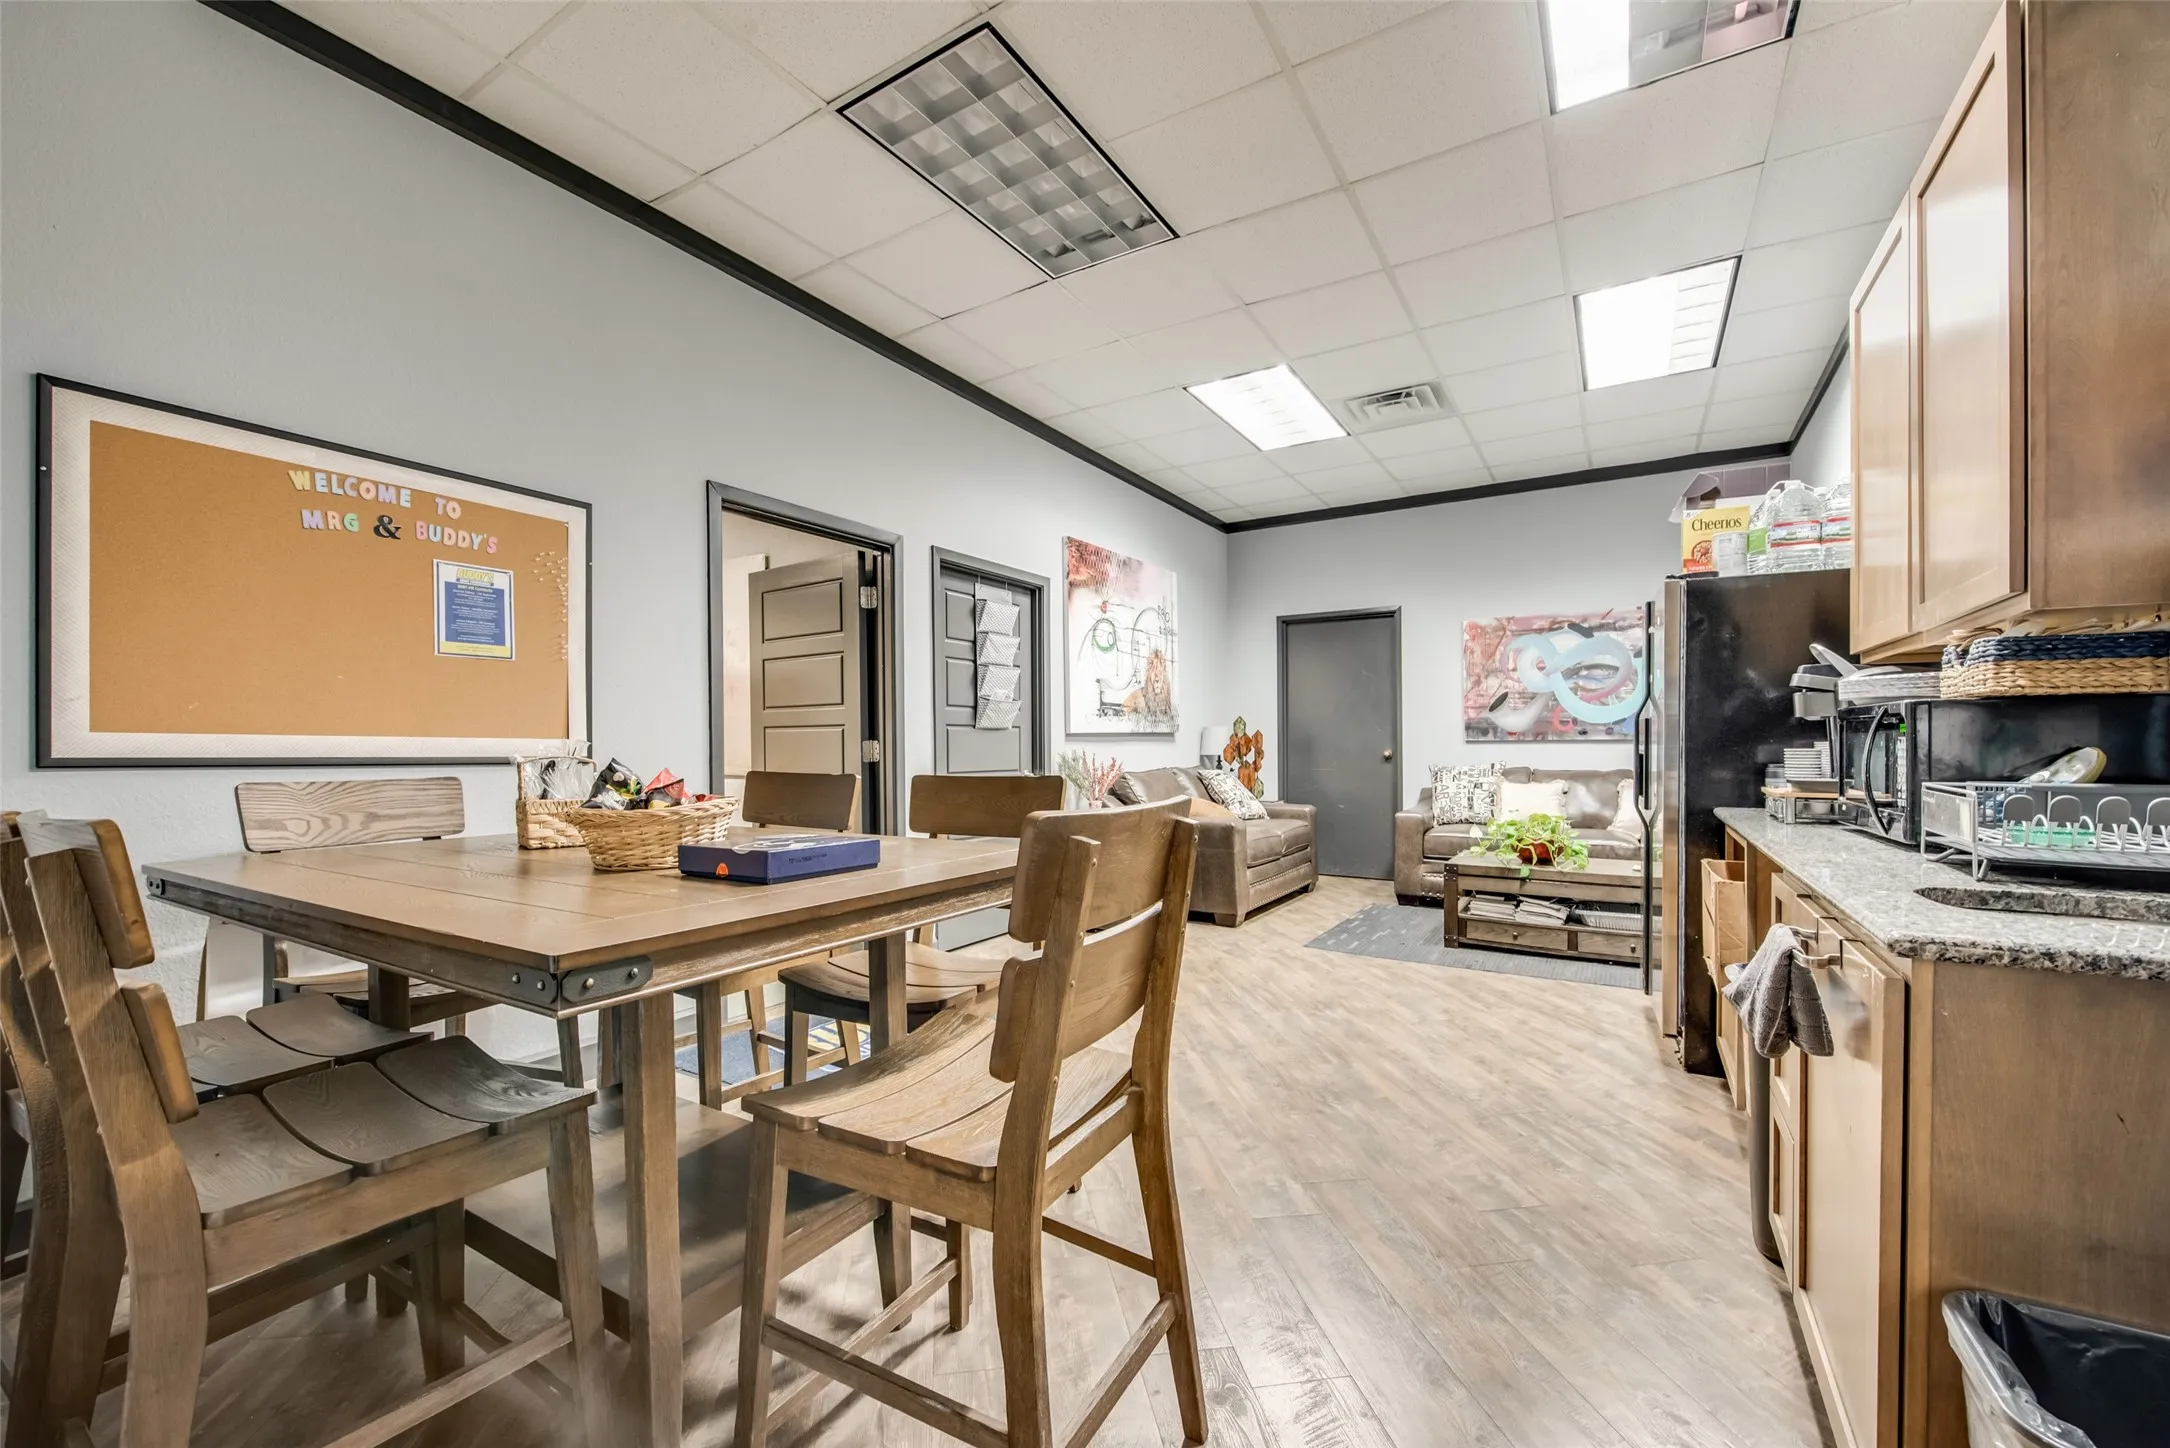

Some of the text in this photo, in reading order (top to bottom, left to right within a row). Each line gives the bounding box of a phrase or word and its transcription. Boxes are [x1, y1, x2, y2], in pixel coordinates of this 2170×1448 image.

[288, 470, 462, 520] WELCOME TO
[301, 509, 498, 554] MRG & BUDDY'S
[1691, 518, 1742, 532] Cheerios
